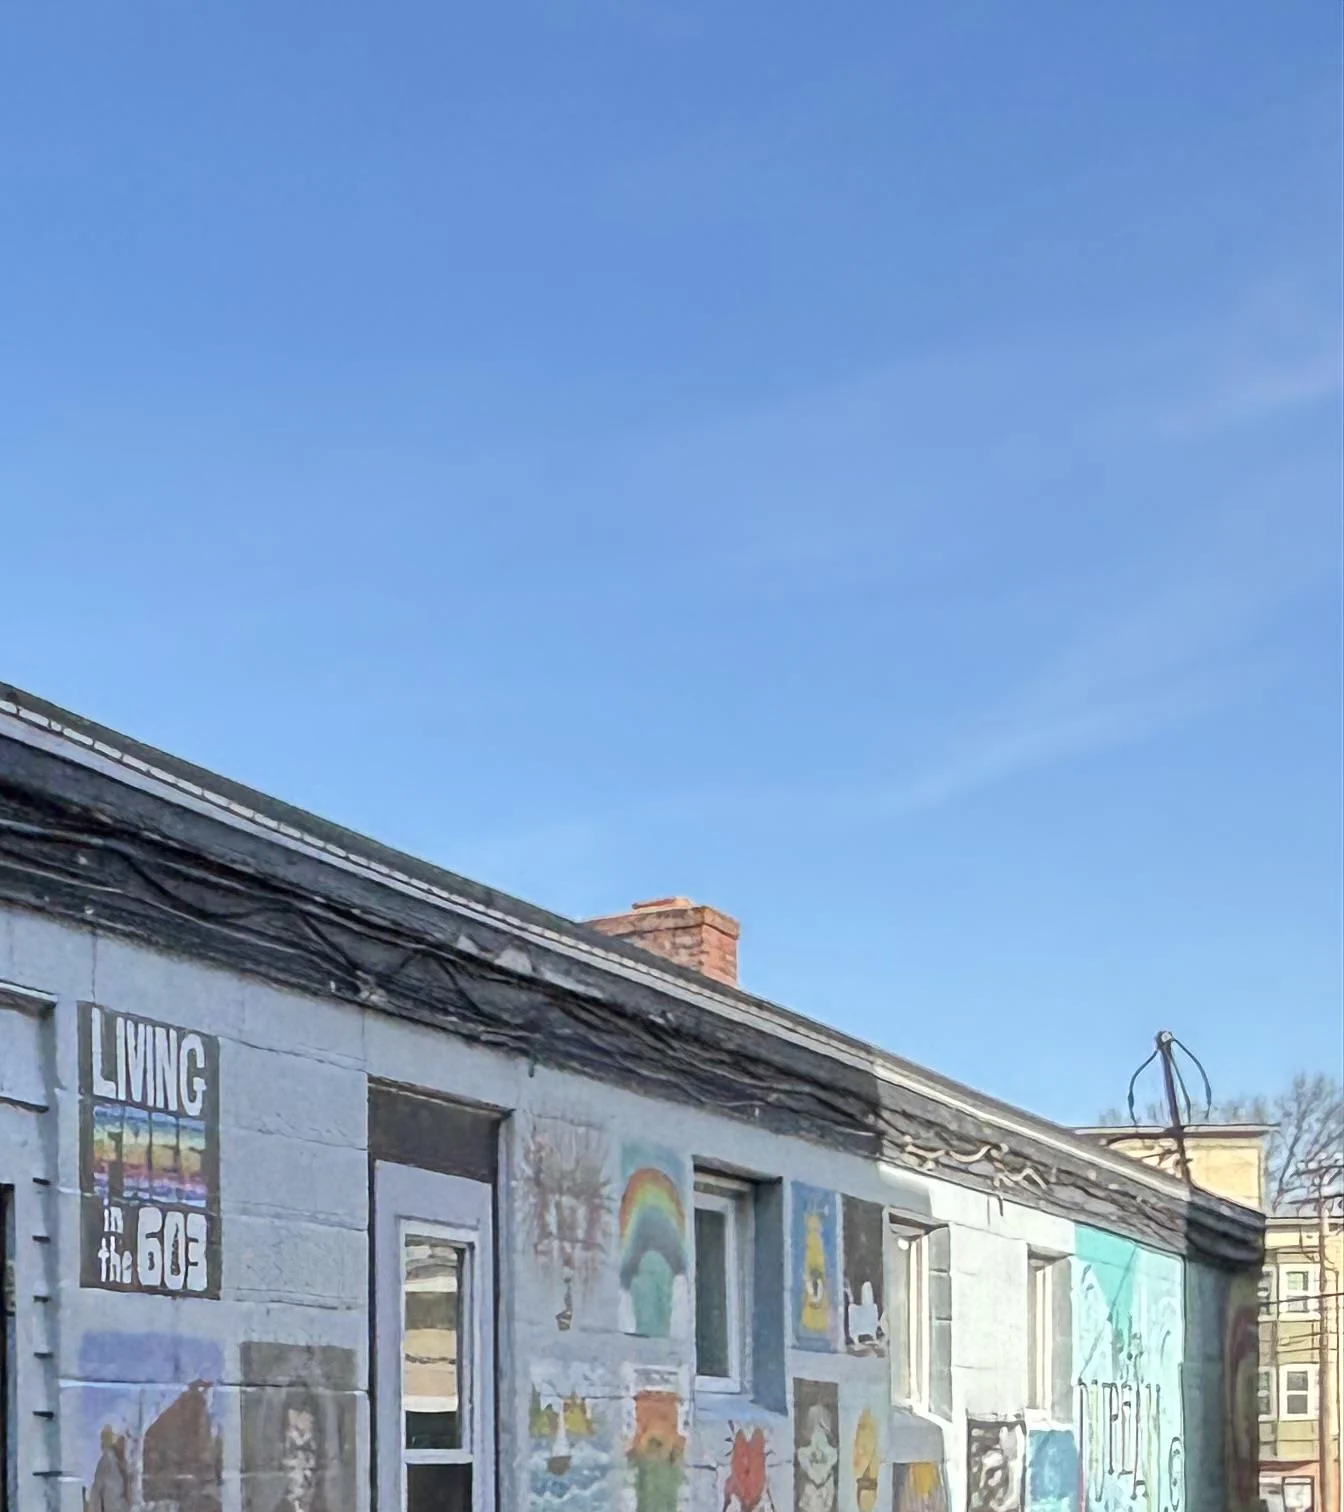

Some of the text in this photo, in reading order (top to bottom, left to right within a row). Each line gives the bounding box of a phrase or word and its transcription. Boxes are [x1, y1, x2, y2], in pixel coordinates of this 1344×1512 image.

[92, 1007, 206, 1117] LIVING
[98, 1207, 208, 1291] the 603
